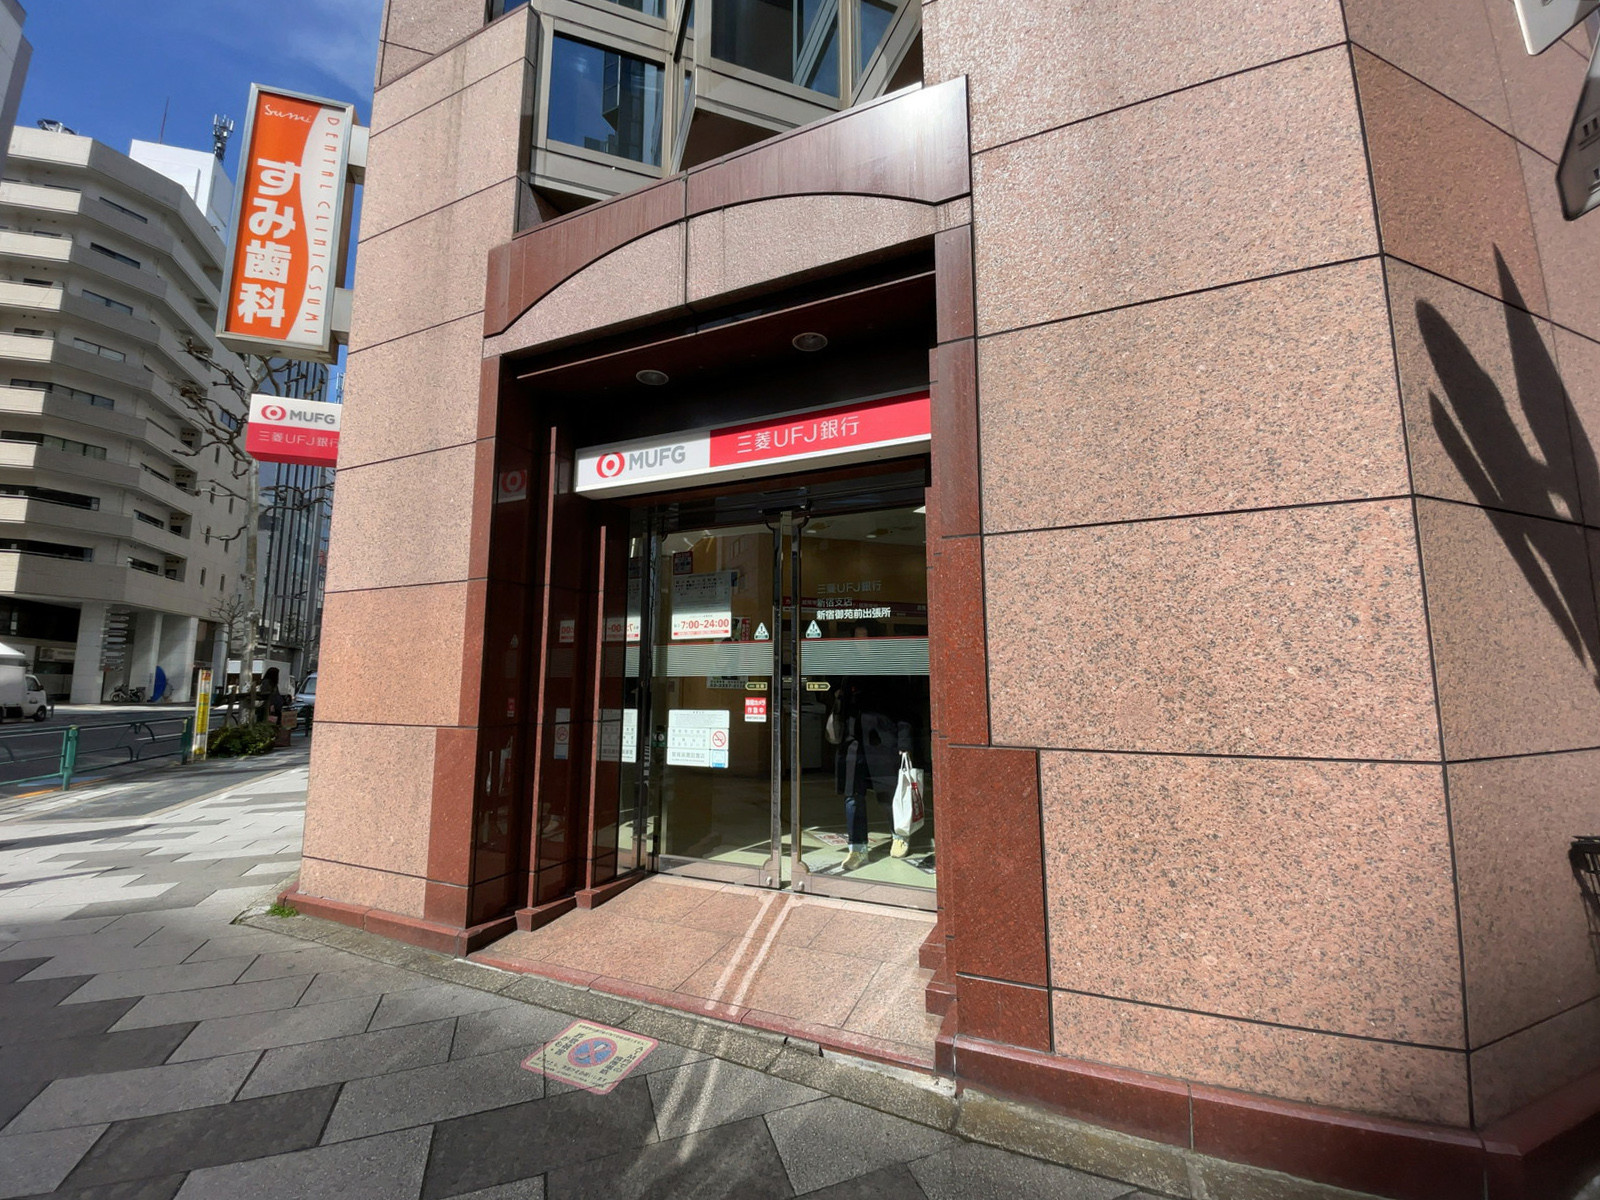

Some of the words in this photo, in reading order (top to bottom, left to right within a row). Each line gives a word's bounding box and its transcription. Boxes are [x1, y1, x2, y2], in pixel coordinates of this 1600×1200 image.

[319, 116, 340, 189] DENTAL
[237, 158, 301, 328] すみ歯科
[310, 201, 331, 273] CLINIC
[304, 284, 322, 334] SUMI
[289, 409, 336, 425] MUFG
[736, 416, 860, 454] 三菱UFJ銀行
[628, 445, 686, 471] MUFG
[817, 580, 882, 594] 三菱UFJ銀行
[816, 607, 891, 620] 新宿御苑前出張所
